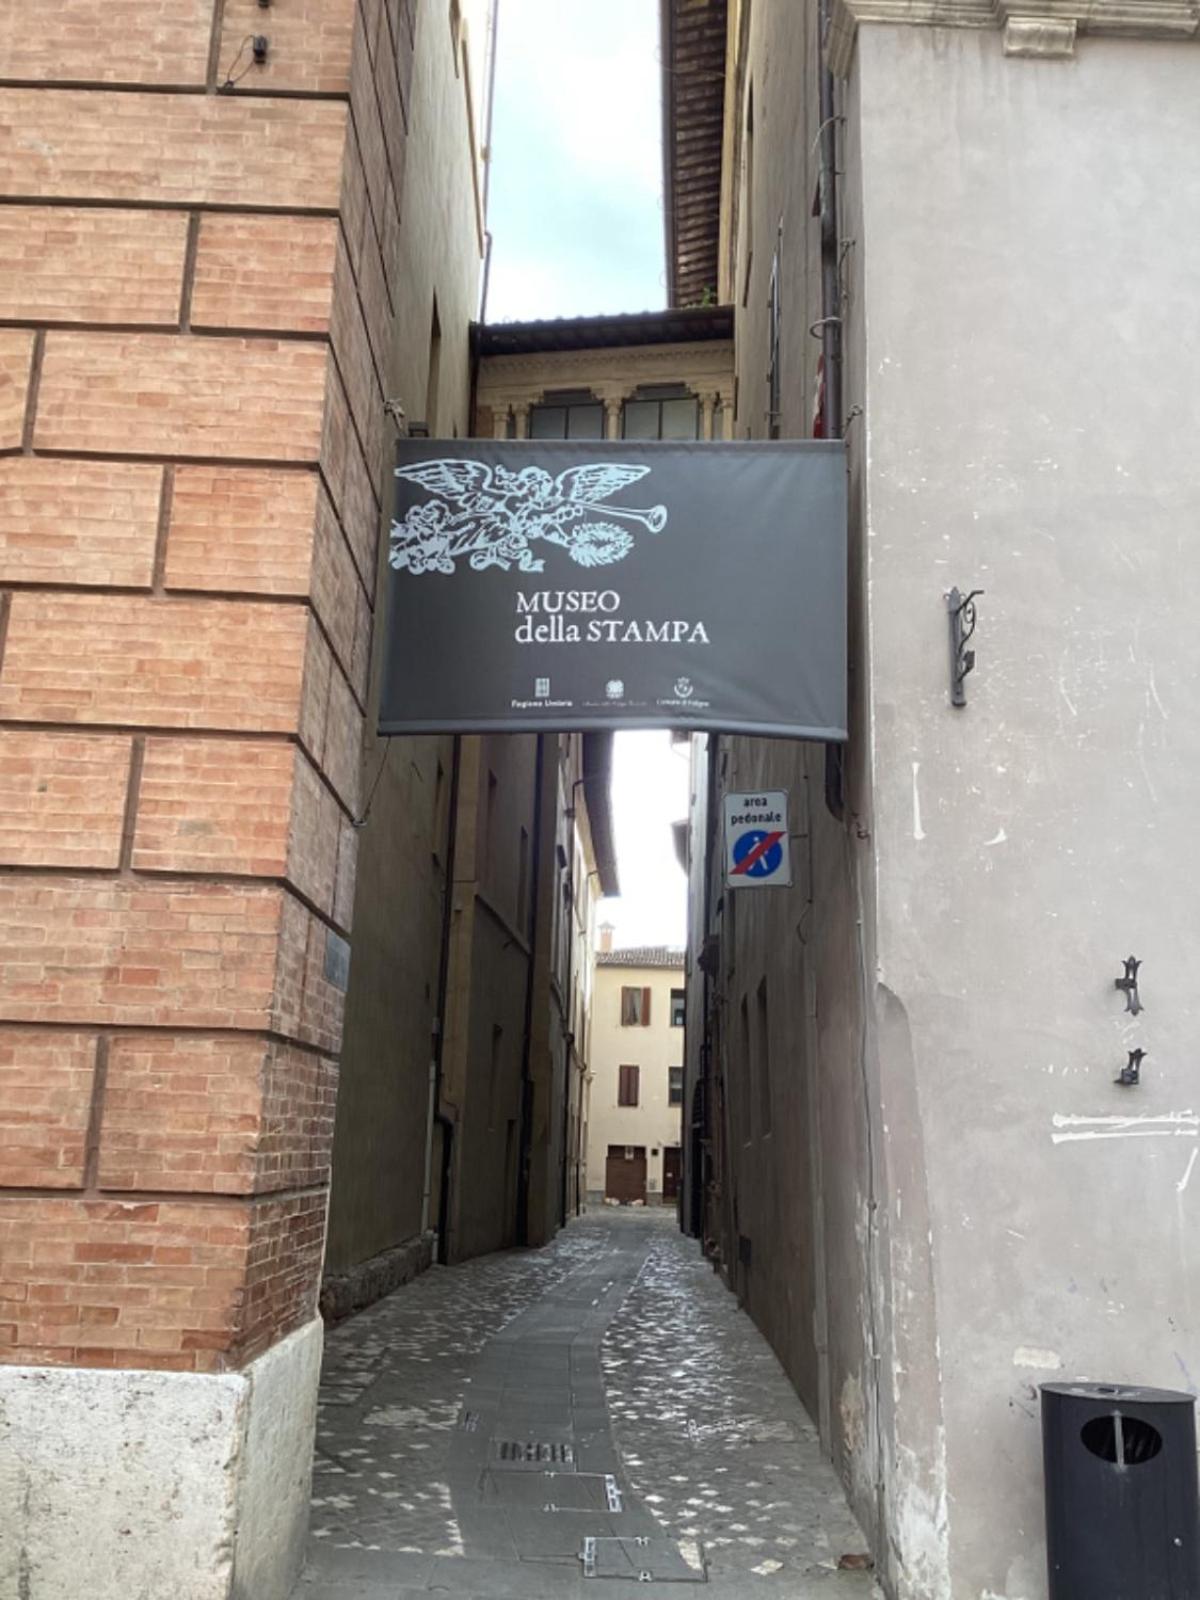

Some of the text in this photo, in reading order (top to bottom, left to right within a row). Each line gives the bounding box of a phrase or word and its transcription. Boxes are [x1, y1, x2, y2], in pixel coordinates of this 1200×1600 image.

[516, 589, 620, 613] MUSEO
[514, 614, 710, 643] della STAMPA
[743, 797, 768, 807] area
[731, 811, 782, 826] pedonale
